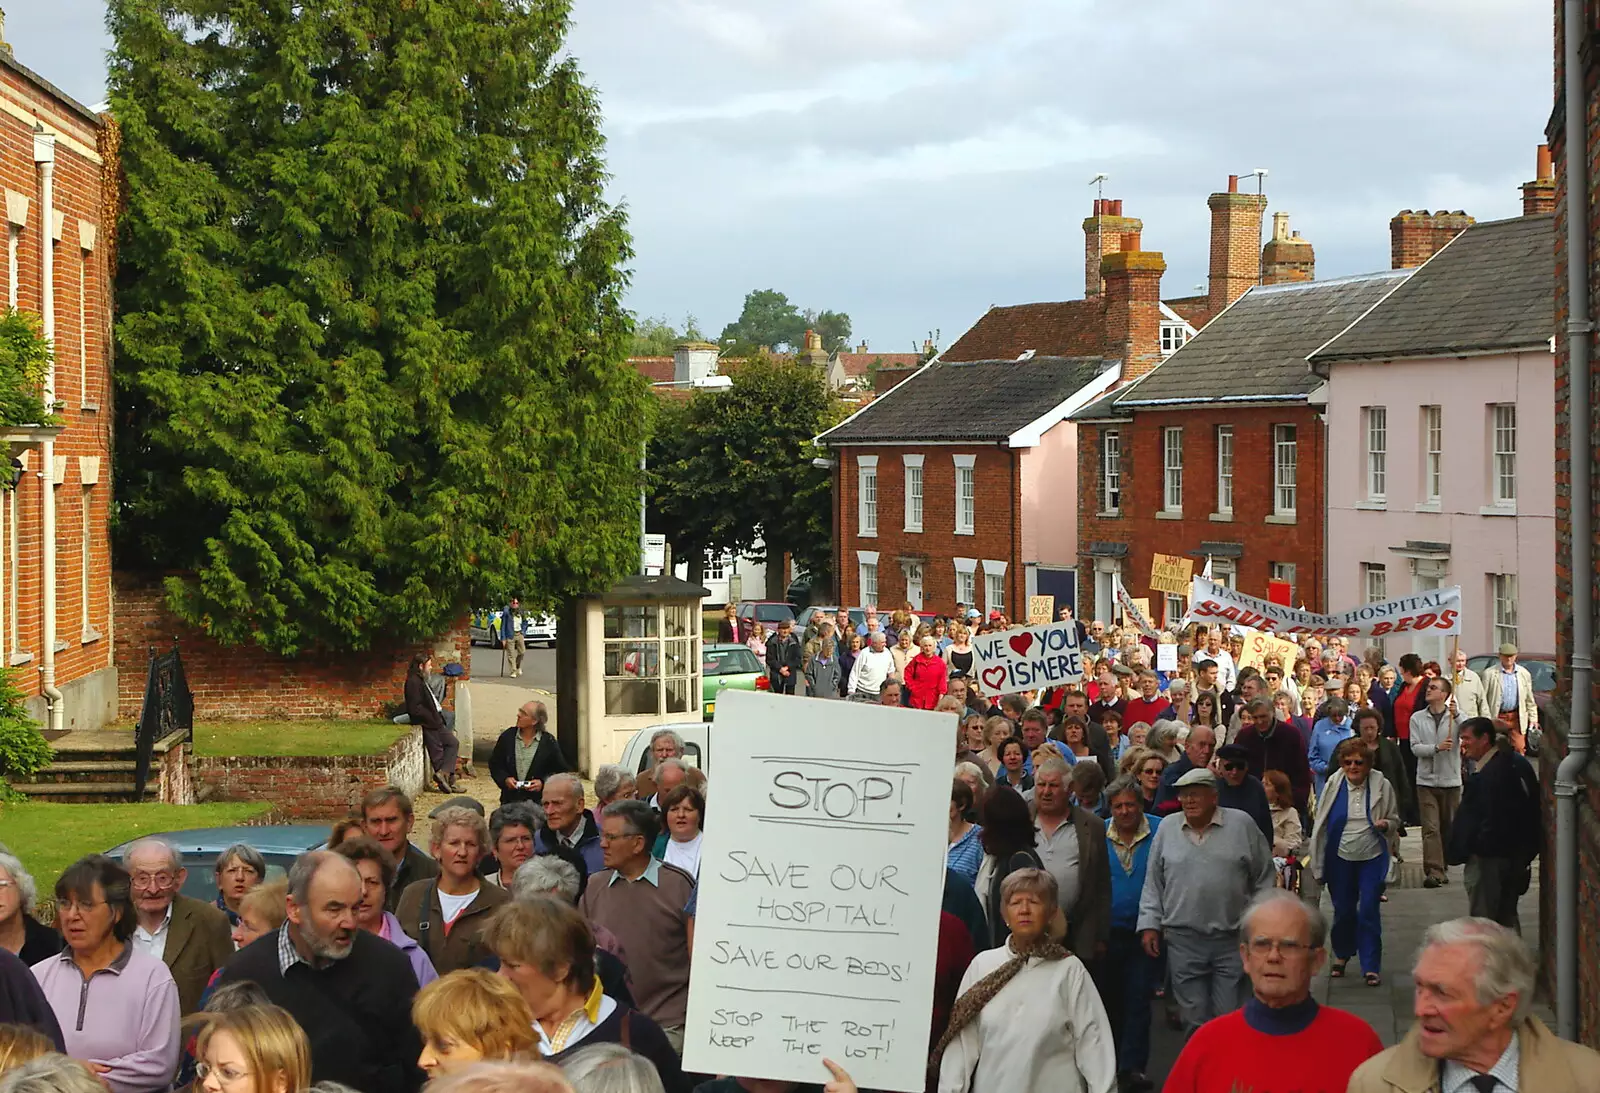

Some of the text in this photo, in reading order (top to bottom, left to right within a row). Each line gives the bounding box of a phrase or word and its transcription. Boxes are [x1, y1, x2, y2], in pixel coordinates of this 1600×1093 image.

[1031, 597, 1052, 607] SAVE
[1033, 606, 1050, 616] OUR
[1193, 600, 1278, 631] SAVE
[1370, 609, 1459, 637] BEDS
[1211, 584, 1339, 625] HARTISMERE
[1345, 594, 1448, 624] HOSPITAL
[974, 627, 1078, 661] WE YOU
[769, 771, 907, 819] STOP!
[720, 851, 909, 896] SAVE OUR
[757, 897, 894, 927] HOSPITAL!
[710, 941, 911, 982] SAVE OUR BEDS!
[710, 1009, 896, 1041] STOP THE ROT!
[709, 1028, 891, 1062] KEEP THE LOT!
